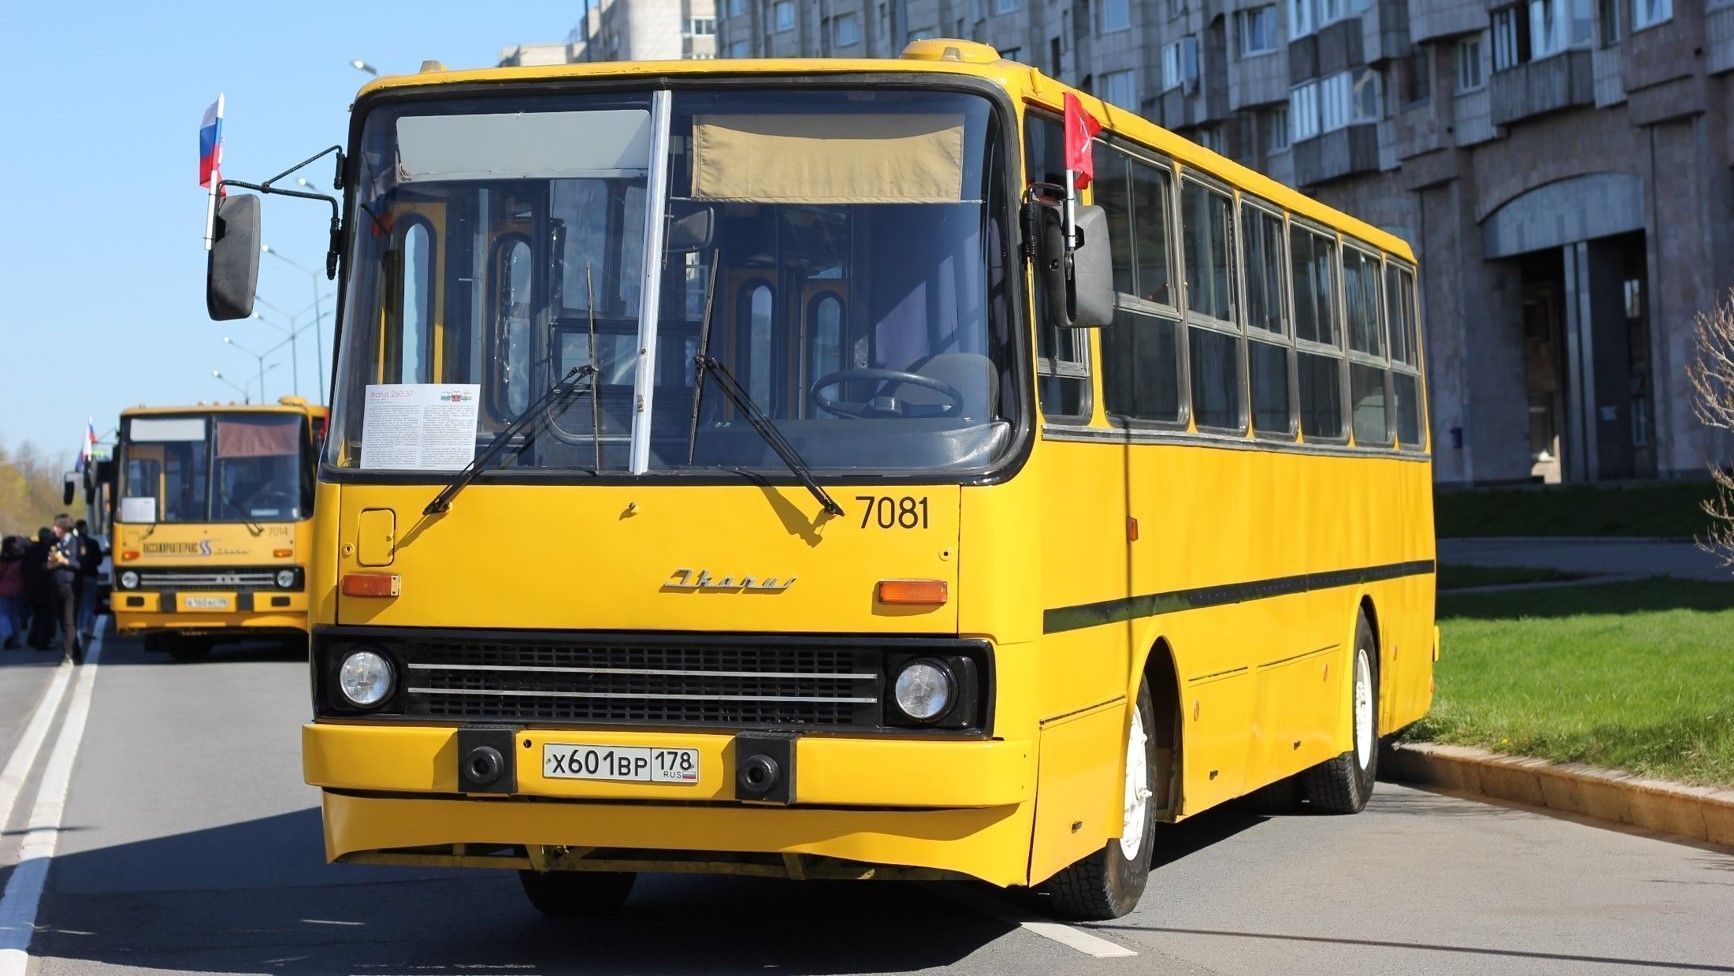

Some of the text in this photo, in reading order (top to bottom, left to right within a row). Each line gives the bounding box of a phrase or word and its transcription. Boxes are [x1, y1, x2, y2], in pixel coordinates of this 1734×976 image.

[855, 495, 929, 529] 7081
[267, 526, 288, 537] 7014
[663, 568, 797, 590] Ikarus
[655, 750, 692, 771] 178
[663, 770, 682, 779] RUS
